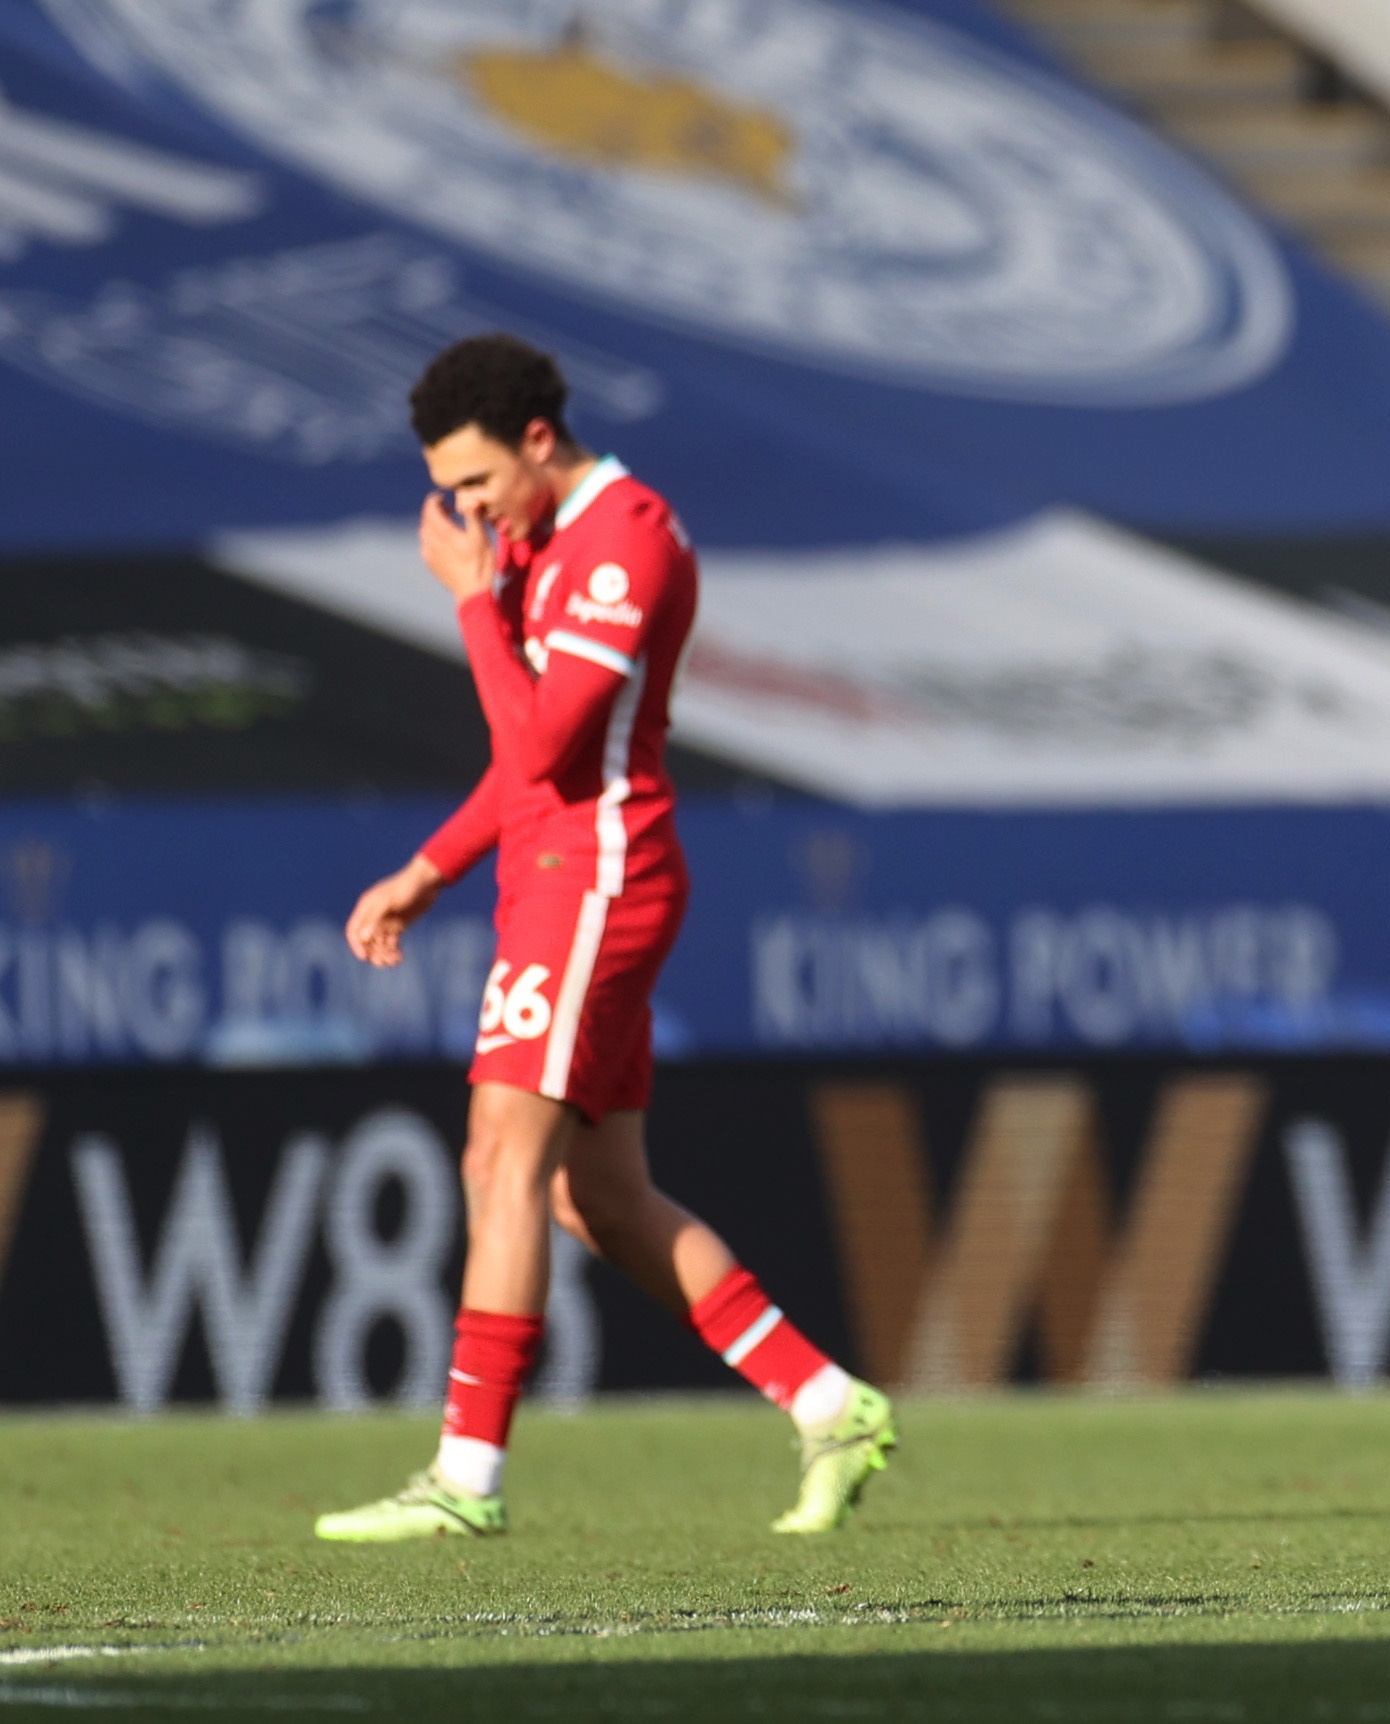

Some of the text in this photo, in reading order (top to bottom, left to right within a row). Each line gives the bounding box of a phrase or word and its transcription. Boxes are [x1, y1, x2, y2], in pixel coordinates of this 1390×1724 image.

[0, 915, 204, 1060] ING
[479, 959, 552, 1040] 66
[752, 905, 1340, 1052] KING POWER
